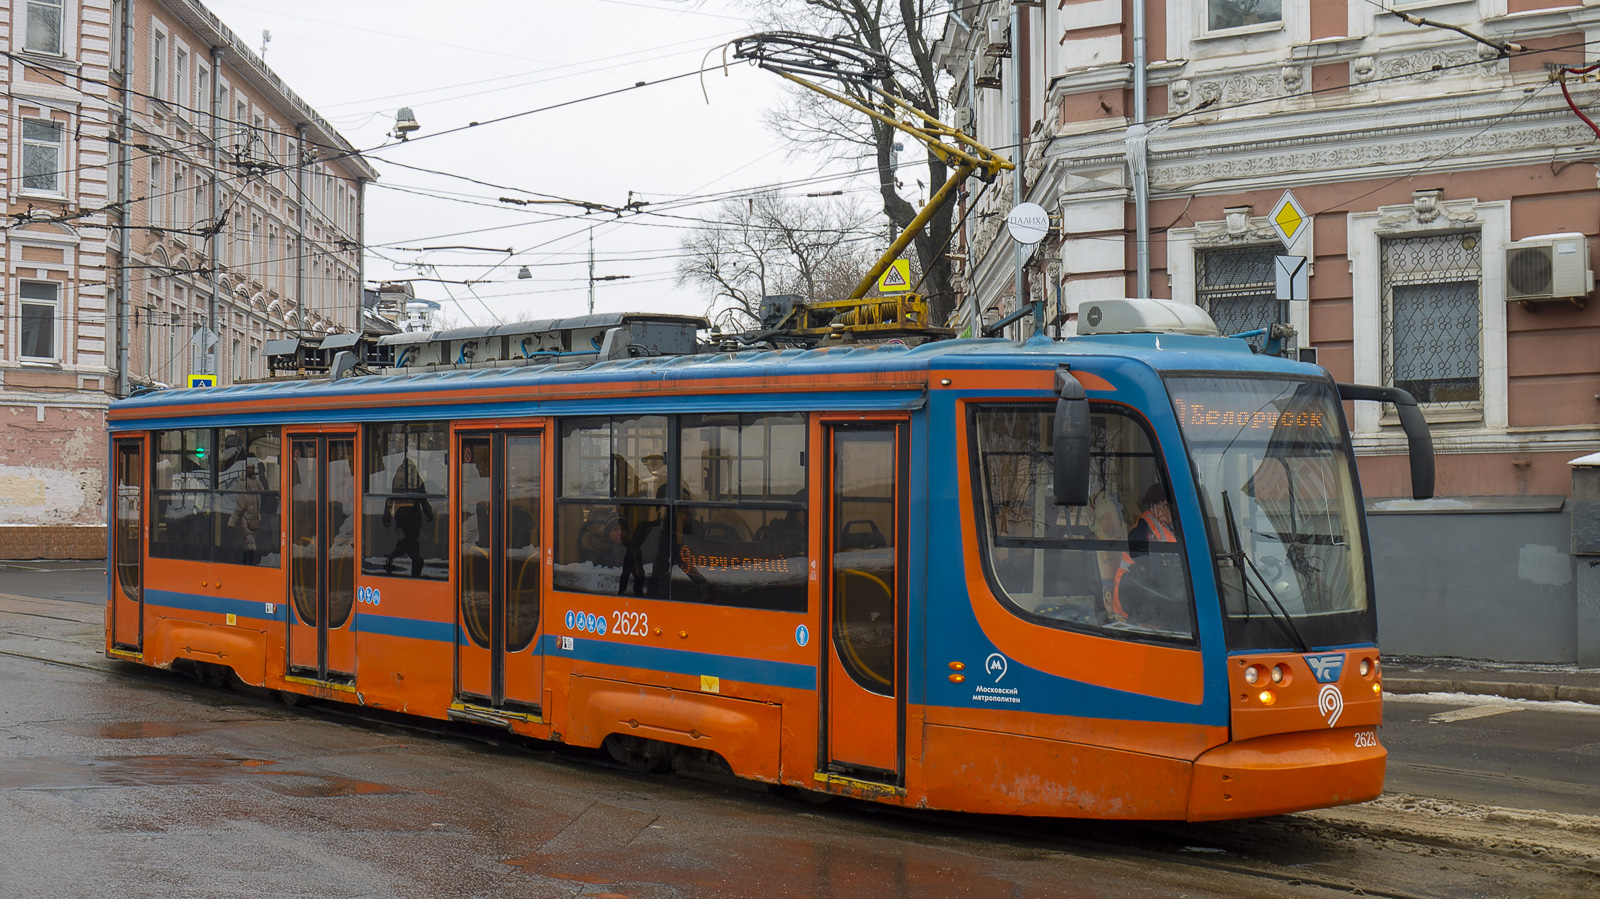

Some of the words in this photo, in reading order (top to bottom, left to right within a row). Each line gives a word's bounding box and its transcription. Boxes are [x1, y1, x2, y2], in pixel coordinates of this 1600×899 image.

[612, 610, 649, 637] 2623
[975, 685, 1019, 695] Московский
[972, 694, 1021, 704] метрополитен
[1354, 731, 1377, 747] 2623
